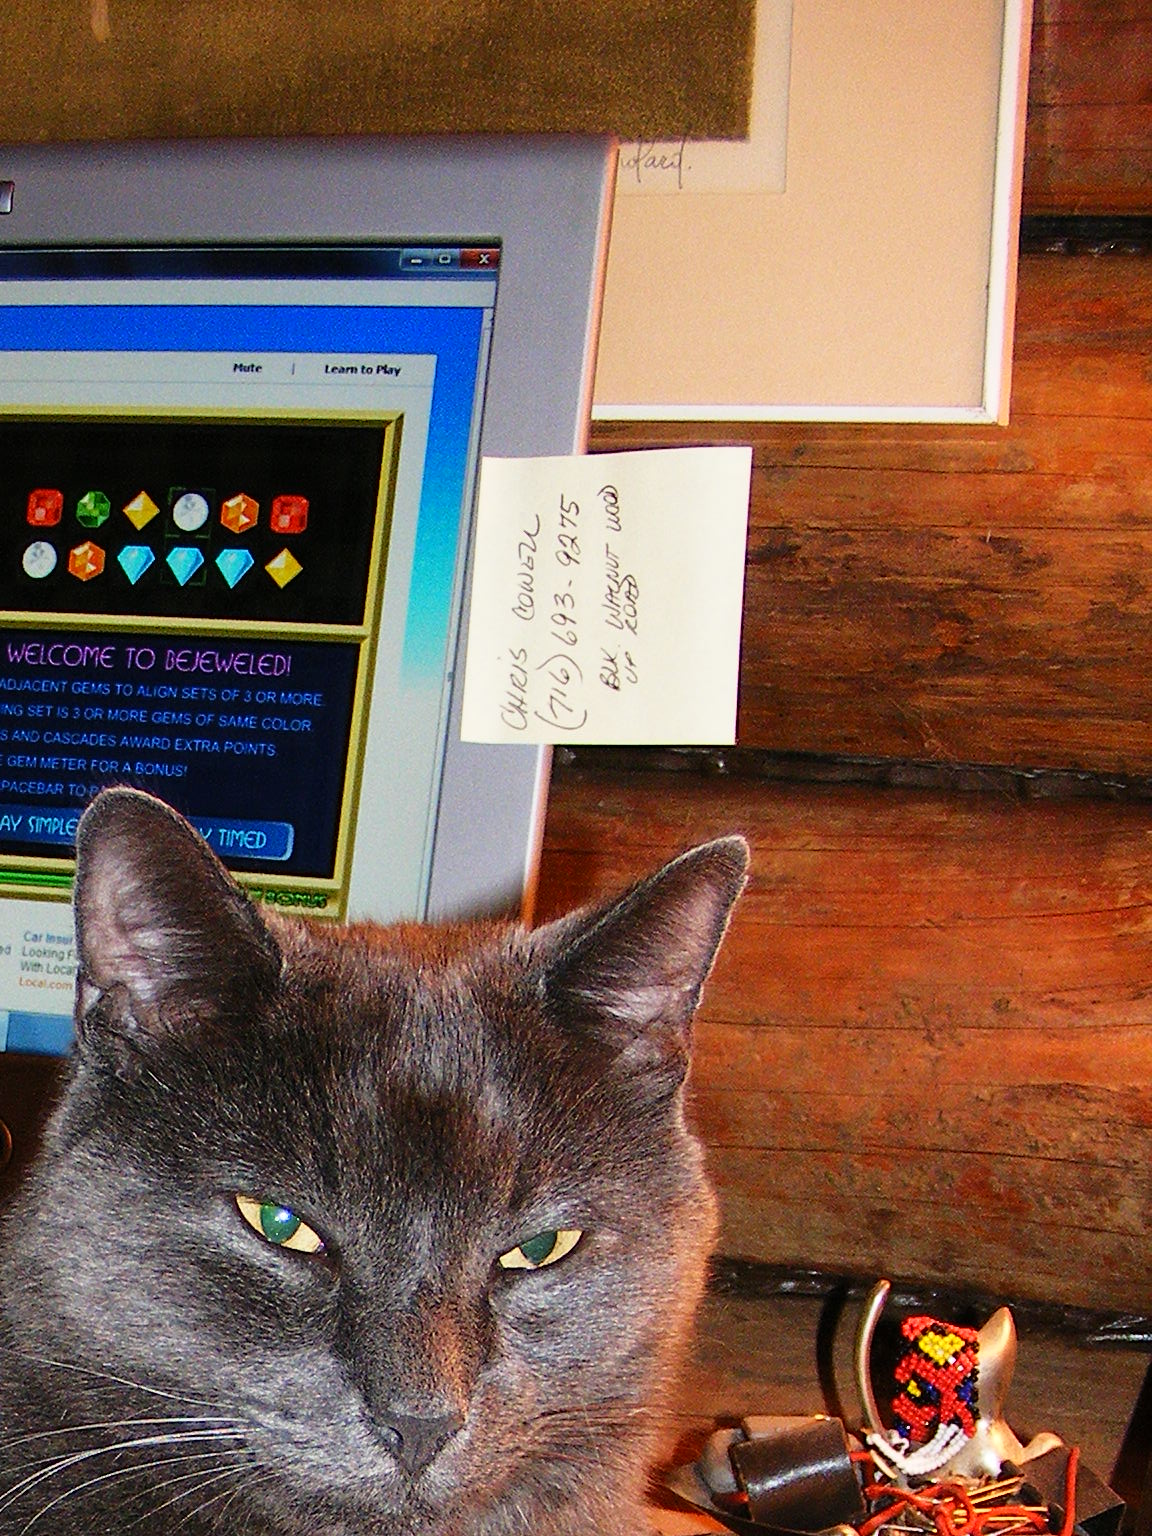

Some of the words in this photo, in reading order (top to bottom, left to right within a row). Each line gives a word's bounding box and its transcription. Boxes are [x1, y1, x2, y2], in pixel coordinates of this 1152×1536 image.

[233, 363, 263, 373] Mute
[324, 364, 358, 375] Learn
[361, 364, 374, 375] to
[375, 364, 402, 377] Play
[7, 642, 116, 668] WELCOME
[126, 647, 156, 670] TO
[165, 649, 293, 677] BEJEWELED!
[71, 681, 111, 695] GEMS
[115, 683, 133, 697] TO
[137, 685, 177, 699] ALIGN
[181, 687, 217, 700] SETS
[221, 689, 240, 701] OF
[244, 690, 252, 703] 3
[255, 691, 277, 704] OR
[280, 692, 323, 706] MORE
[534, 653, 587, 731] (716)
[27, 704, 53, 718] SET
[57, 706, 69, 719] IS
[73, 707, 81, 720] 3
[84, 707, 105, 721] OR
[107, 708, 148, 723] MORE
[152, 711, 192, 725] GEMS
[195, 713, 216, 727] OF
[219, 715, 258, 729] SAME
[261, 717, 312, 732] COLOR
[11, 730, 41, 743] AND
[43, 731, 117, 747] CASCADES
[120, 735, 171, 750] AWARD
[174, 738, 221, 753] EXTRA
[224, 741, 277, 757] POINTS
[7, 755, 38, 769] GEM
[40, 756, 88, 771] METER
[90, 759, 119, 773] FOR
[122, 761, 132, 774] A
[135, 761, 188, 777] BONUS!
[68, 783, 88, 798] TO
[28, 815, 79, 836] SIMPLE
[218, 828, 267, 850] TIMED
[23, 930, 43, 943] Car
[21, 945, 65, 962] Looking
[20, 961, 44, 973] With
